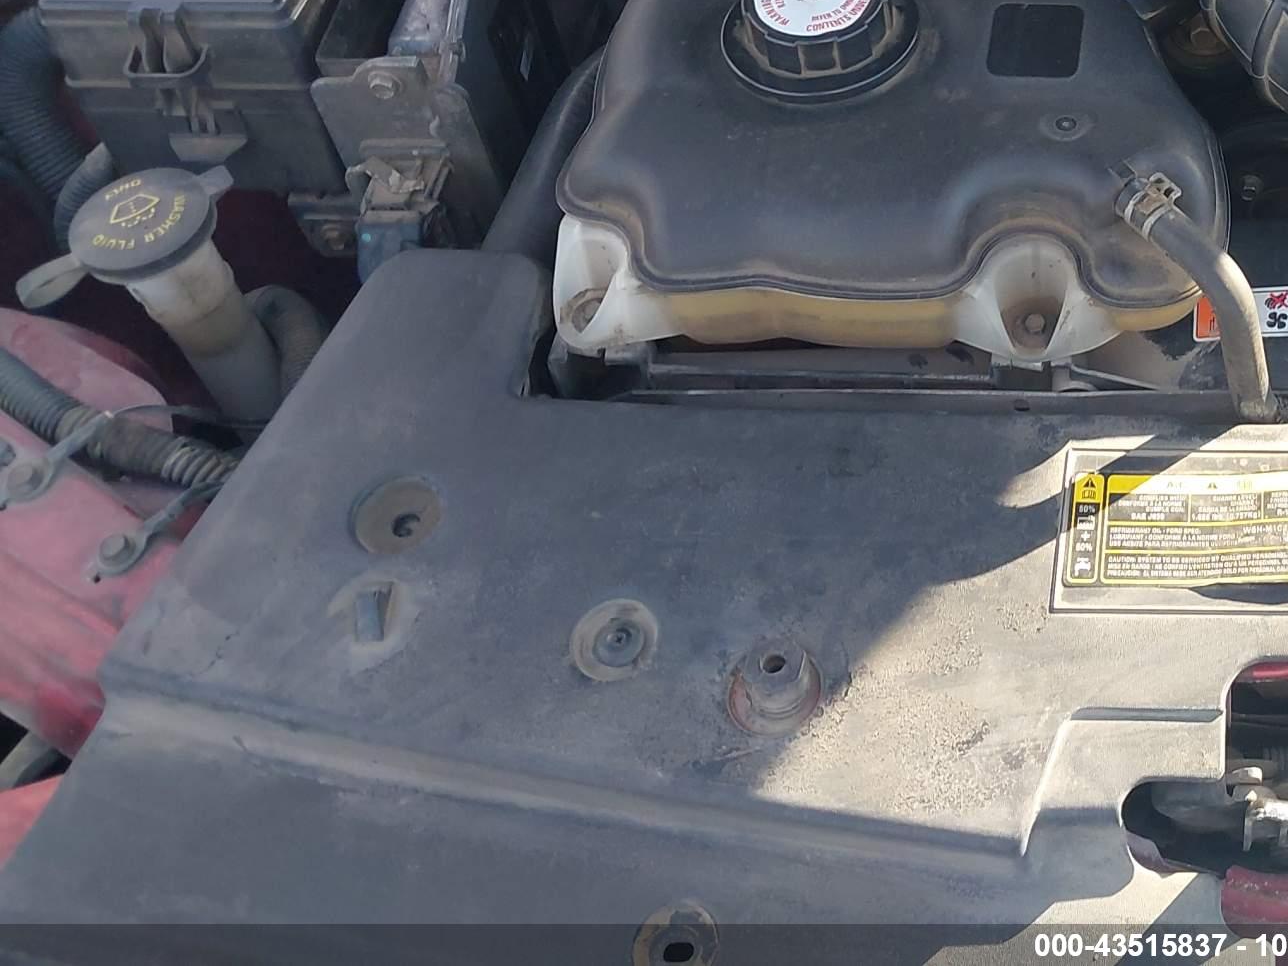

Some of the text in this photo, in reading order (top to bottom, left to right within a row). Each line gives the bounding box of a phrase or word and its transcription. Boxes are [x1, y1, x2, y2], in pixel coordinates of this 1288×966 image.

[806, 14, 851, 32] CONTENTS
[144, 195, 186, 243] WASHER
[92, 233, 136, 250] FLUID
